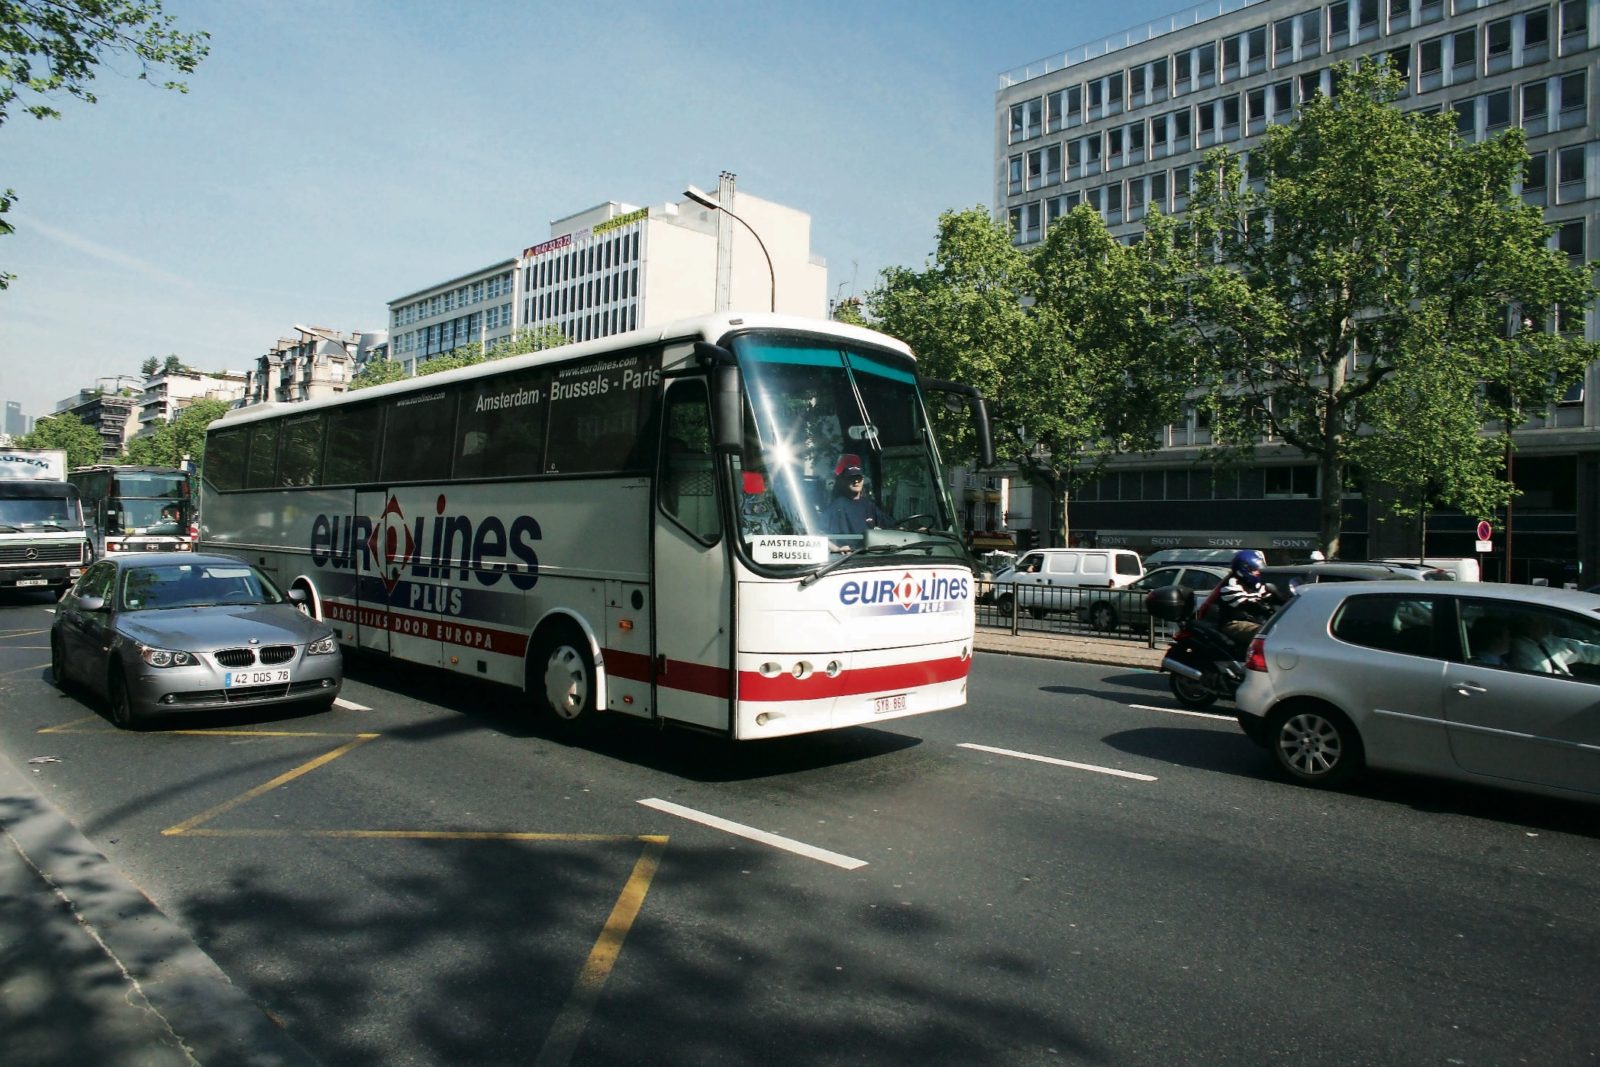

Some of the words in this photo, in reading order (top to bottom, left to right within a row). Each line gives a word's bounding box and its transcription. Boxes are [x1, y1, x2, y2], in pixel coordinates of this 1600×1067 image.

[559, 357, 638, 378] www.eurolines.com
[476, 388, 539, 413] Amsterdam
[550, 374, 609, 400] Brussels
[622, 365, 660, 391] Paris
[760, 539, 821, 548] AMSTERDAM
[1101, 536, 1128, 545] SONY
[1151, 536, 1181, 545] SONY
[1208, 537, 1242, 546] SONY
[1272, 538, 1310, 548] SONY
[772, 551, 812, 560] BRUSSEL
[409, 583, 462, 615] PLUS
[332, 606, 388, 628] DAGELIJKS
[395, 617, 428, 637] DOOR
[437, 623, 492, 649] EUROPA
[235, 673, 248, 684] 42
